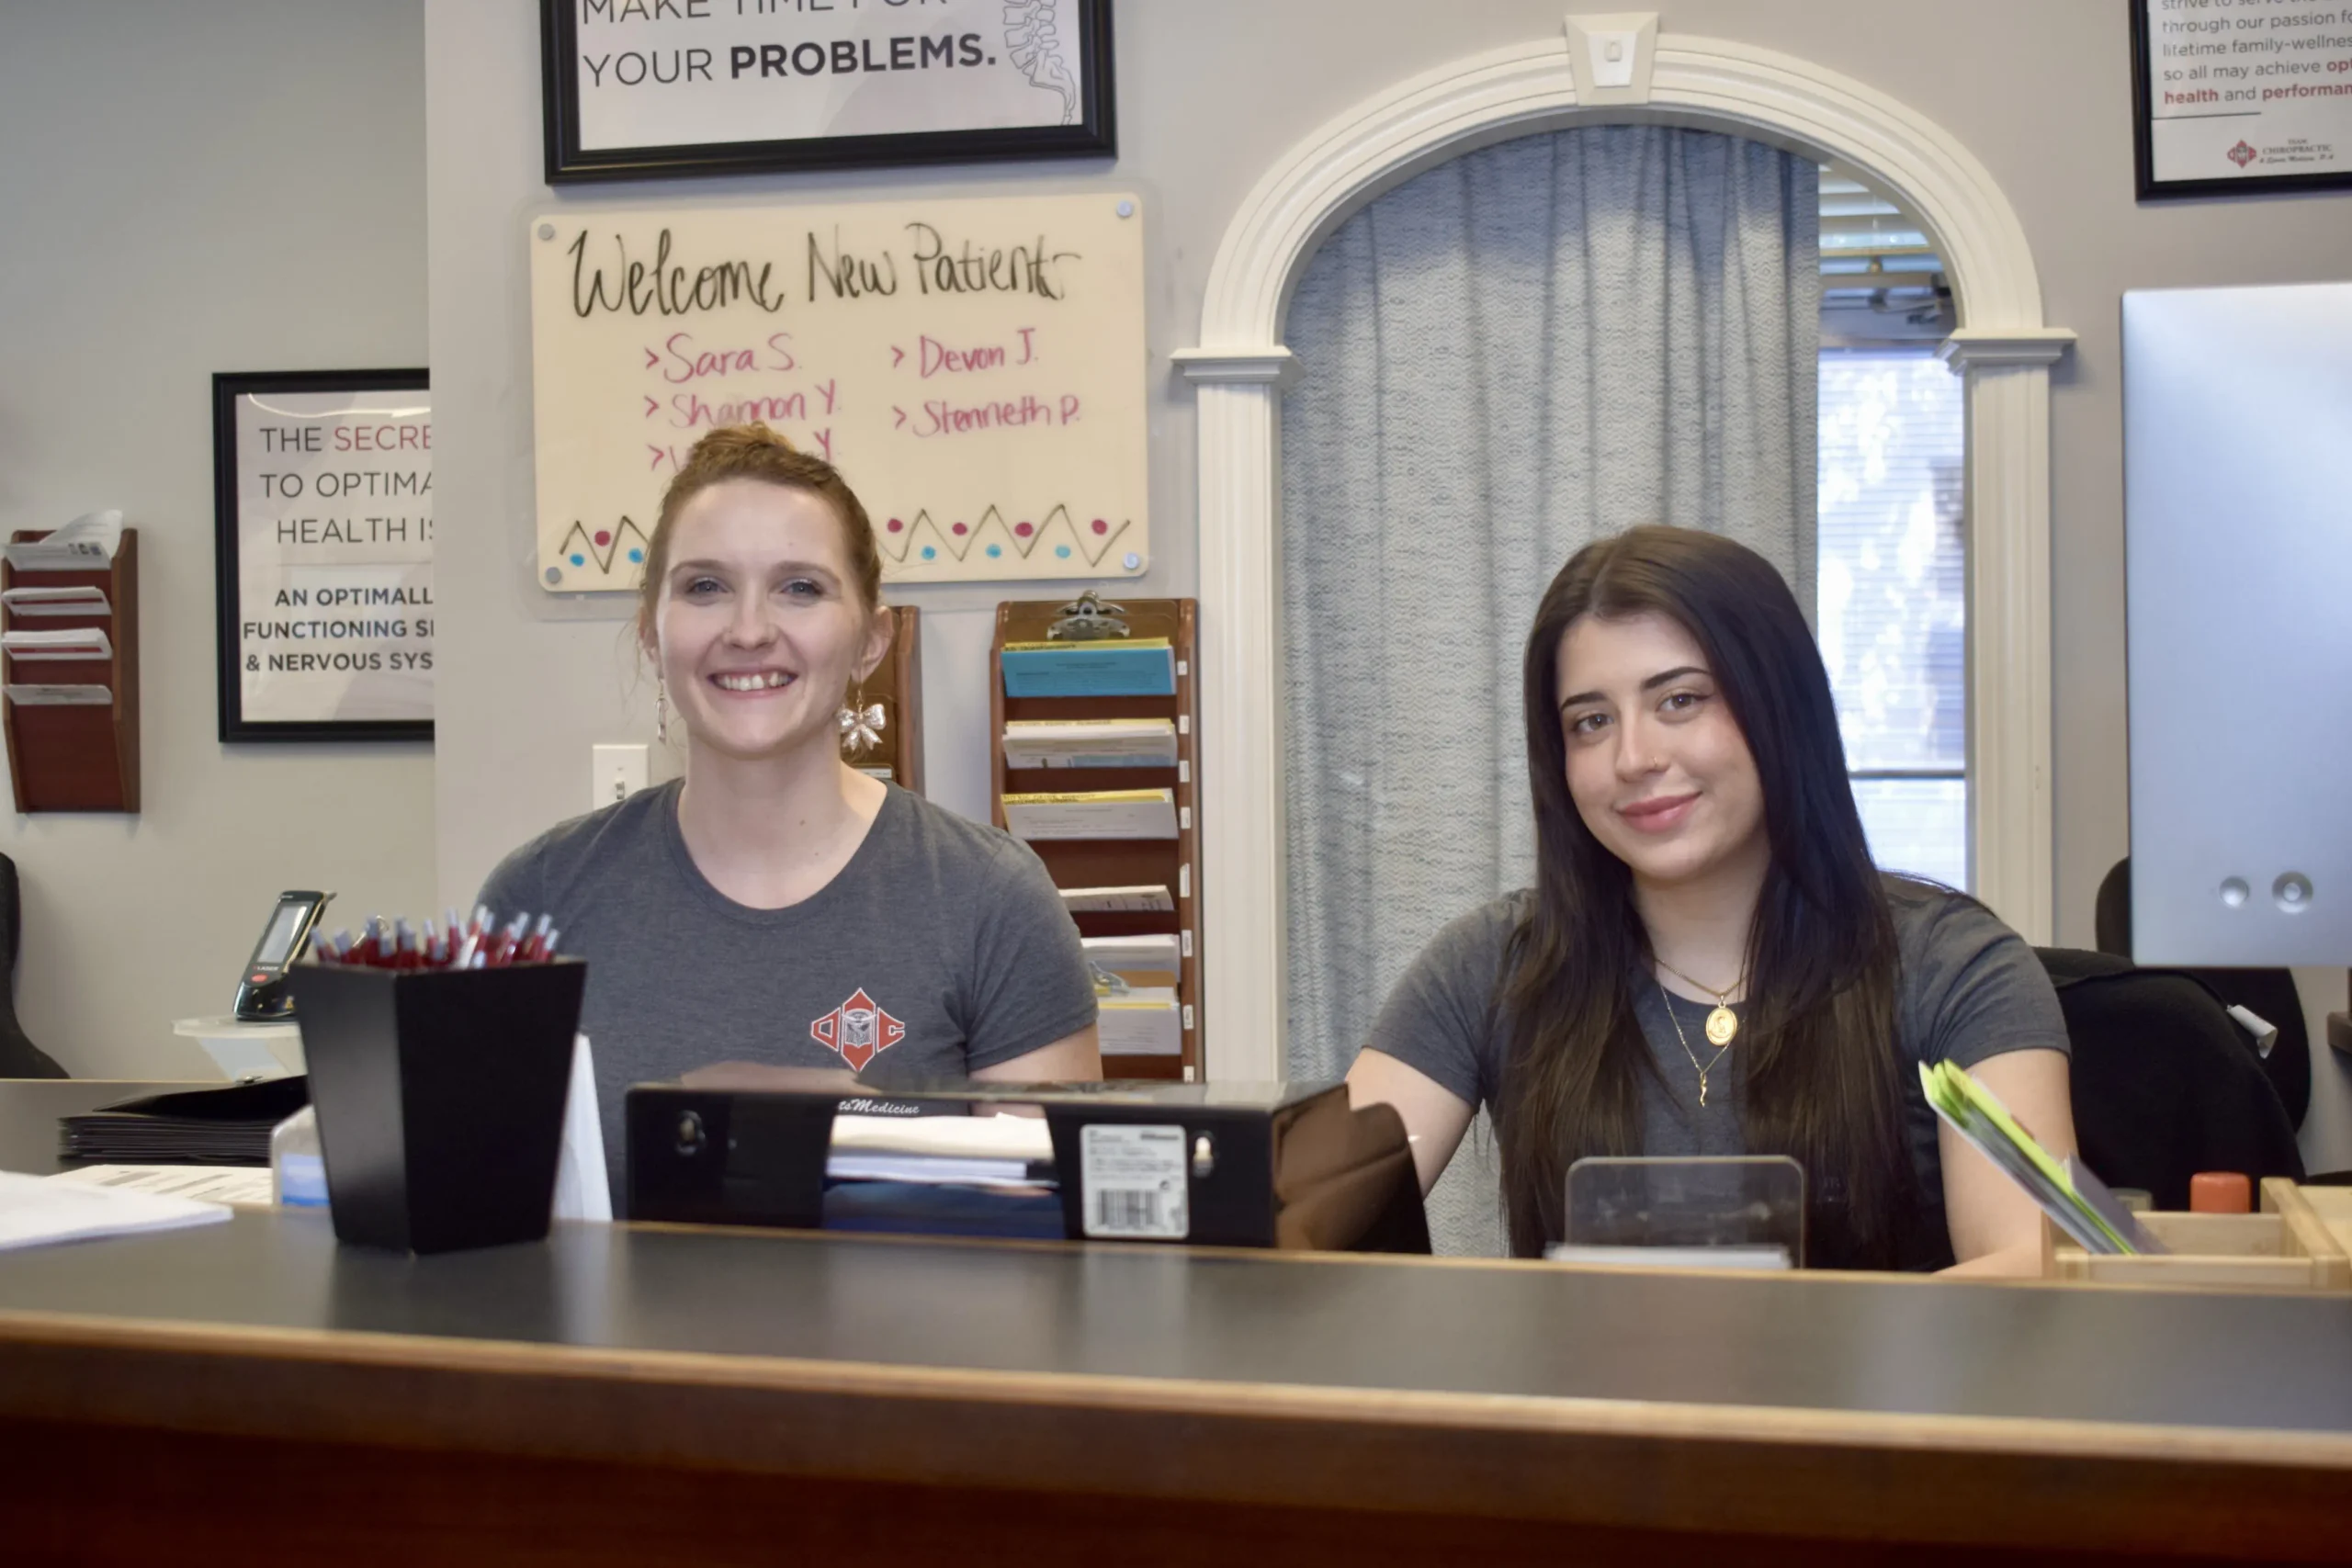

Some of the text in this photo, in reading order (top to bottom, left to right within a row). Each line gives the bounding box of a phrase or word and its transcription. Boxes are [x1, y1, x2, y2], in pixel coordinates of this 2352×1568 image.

[582, 0, 711, 25] MAKE
[2163, 17, 2231, 34] through
[2236, 17, 2264, 30] our
[2270, 11, 2335, 30] passion
[582, 32, 996, 87] YOUR PROBLEMS.
[2163, 42, 2227, 57] lifetime
[2164, 69, 2183, 81] so
[2188, 65, 2207, 80] all
[2213, 65, 2250, 80] may
[2255, 59, 2321, 76] achieve
[2164, 89, 2219, 105] health
[2224, 86, 2256, 101] and
[568, 228, 785, 318] Welcome
[807, 223, 898, 302] New
[663, 332, 761, 384] Sara
[920, 333, 1005, 379] Devon
[259, 426, 322, 453] THE
[259, 472, 304, 499] TO
[277, 516, 406, 544] HEALTH
[275, 588, 309, 607] AN
[243, 618, 408, 640] FUNCTIONING
[245, 653, 260, 671] &
[268, 651, 382, 671] NERVOUS
